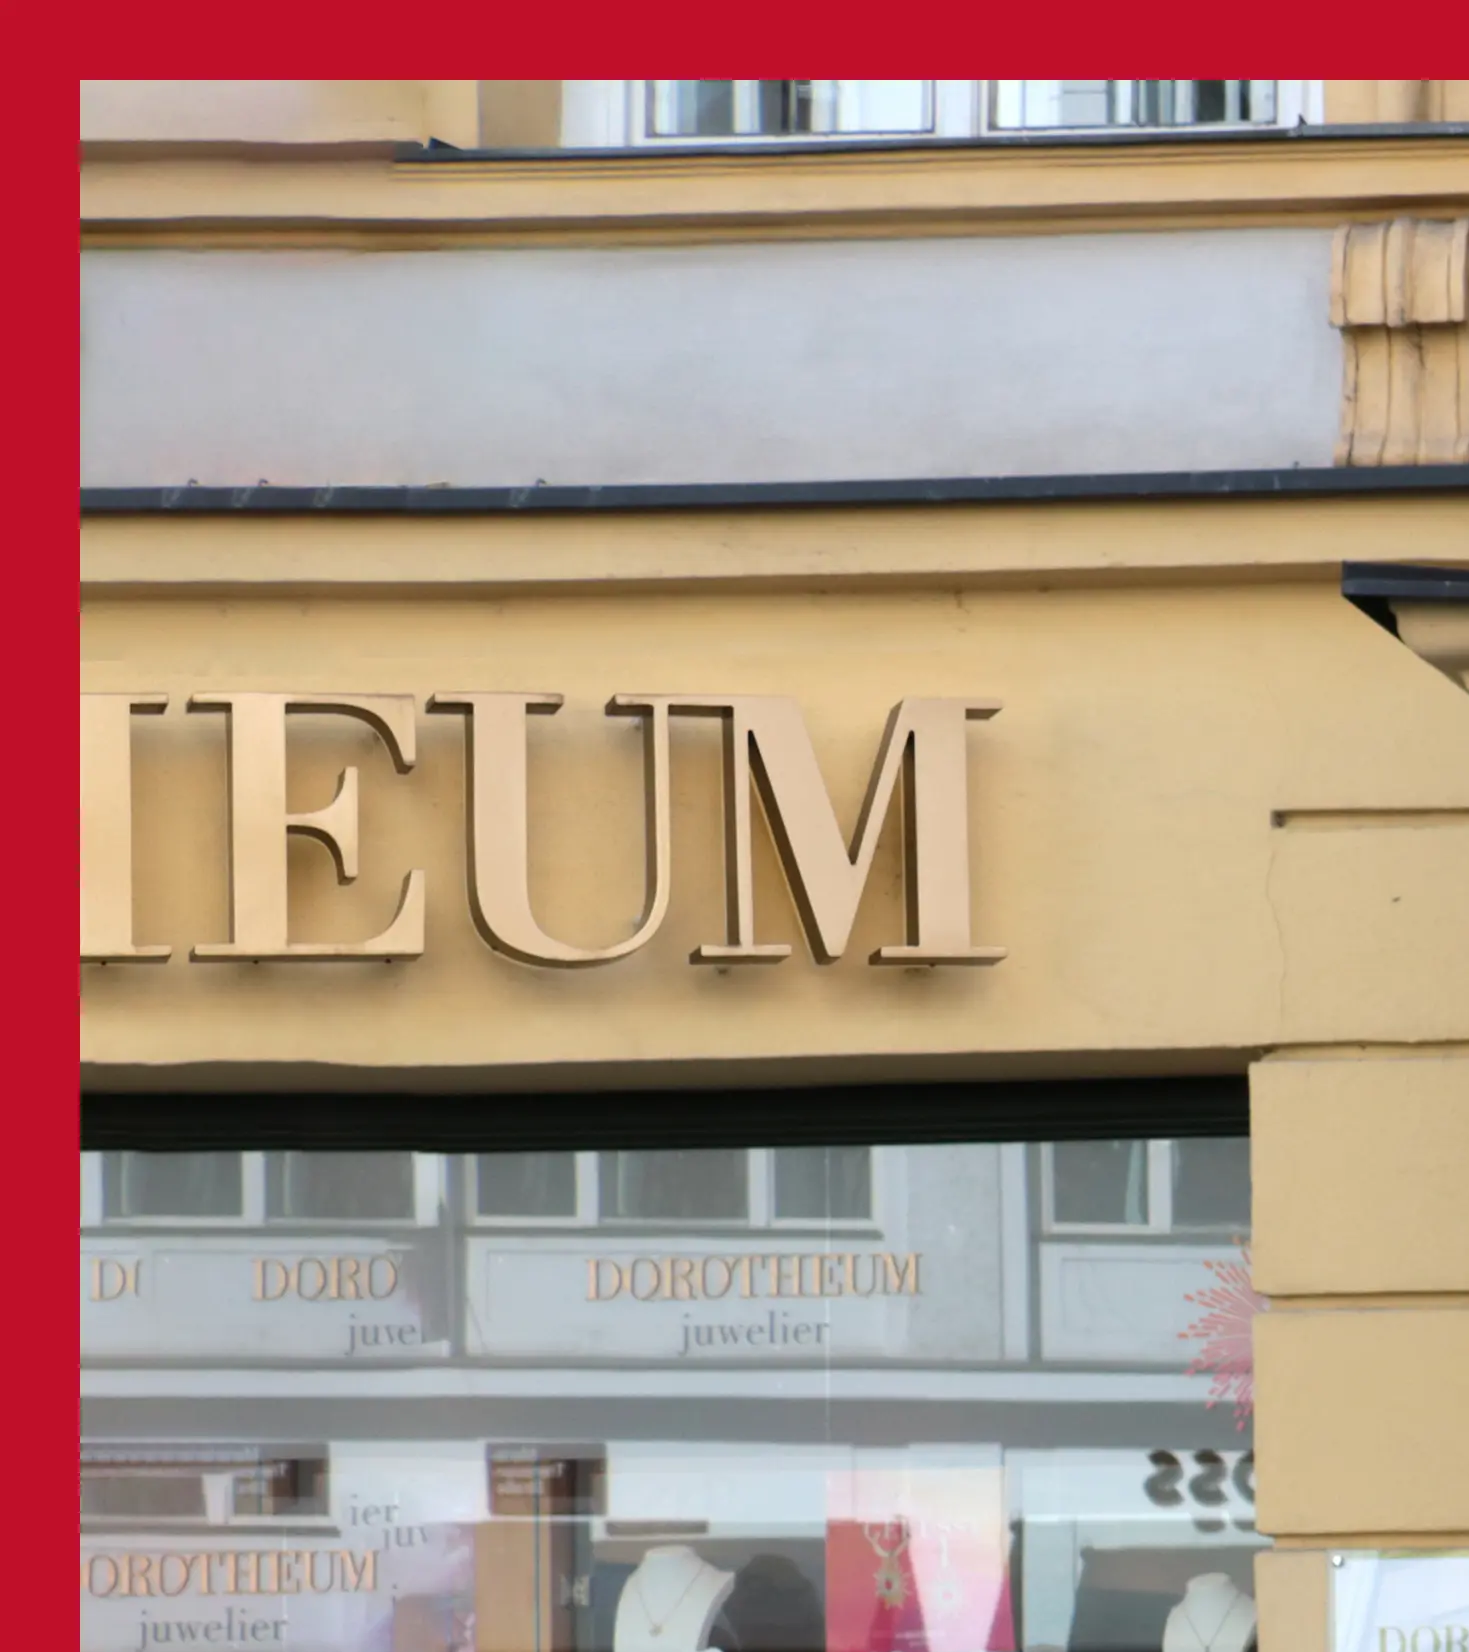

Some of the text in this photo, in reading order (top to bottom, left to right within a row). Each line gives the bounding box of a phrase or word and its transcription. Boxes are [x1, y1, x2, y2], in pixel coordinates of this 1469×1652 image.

[252, 1256, 398, 1300] DORO
[586, 1252, 922, 1301] DOROTHEUM
[678, 1310, 829, 1356] juwelier
[134, 1608, 288, 1652] juwelier
